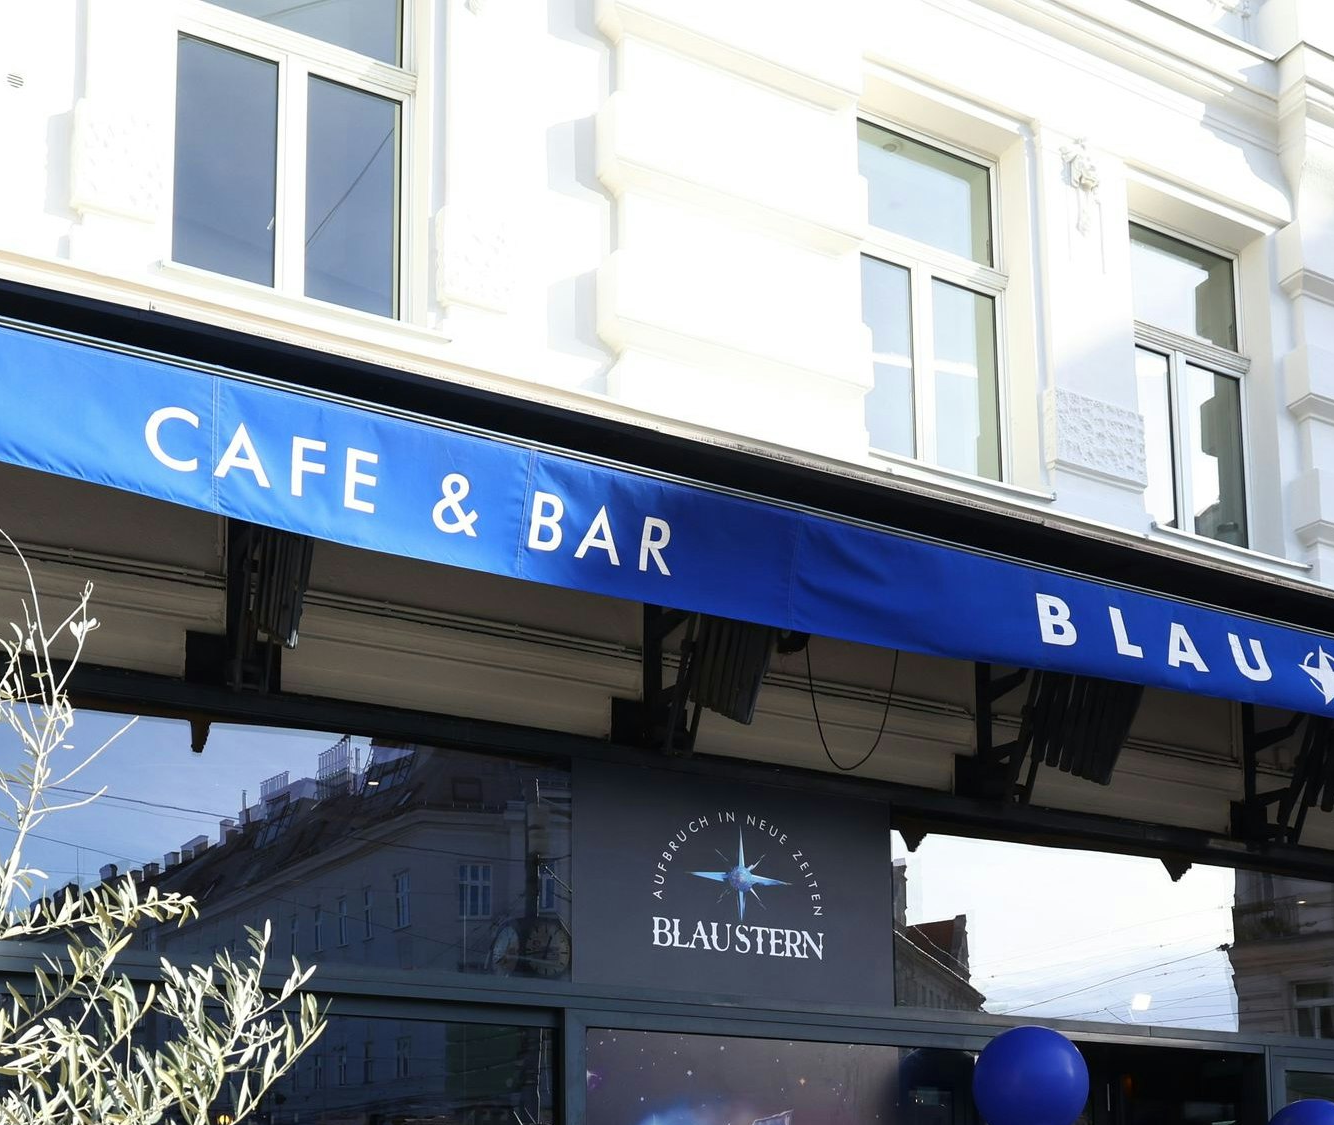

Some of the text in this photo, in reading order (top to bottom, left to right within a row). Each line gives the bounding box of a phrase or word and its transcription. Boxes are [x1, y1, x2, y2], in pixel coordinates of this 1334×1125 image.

[144, 406, 673, 578] CAFE & BAR
[1035, 592, 1274, 682] BLAU
[652, 811, 823, 916] AUFBRUCH IN NEUE ZEITEN
[652, 916, 824, 961] BLAUSTERN
